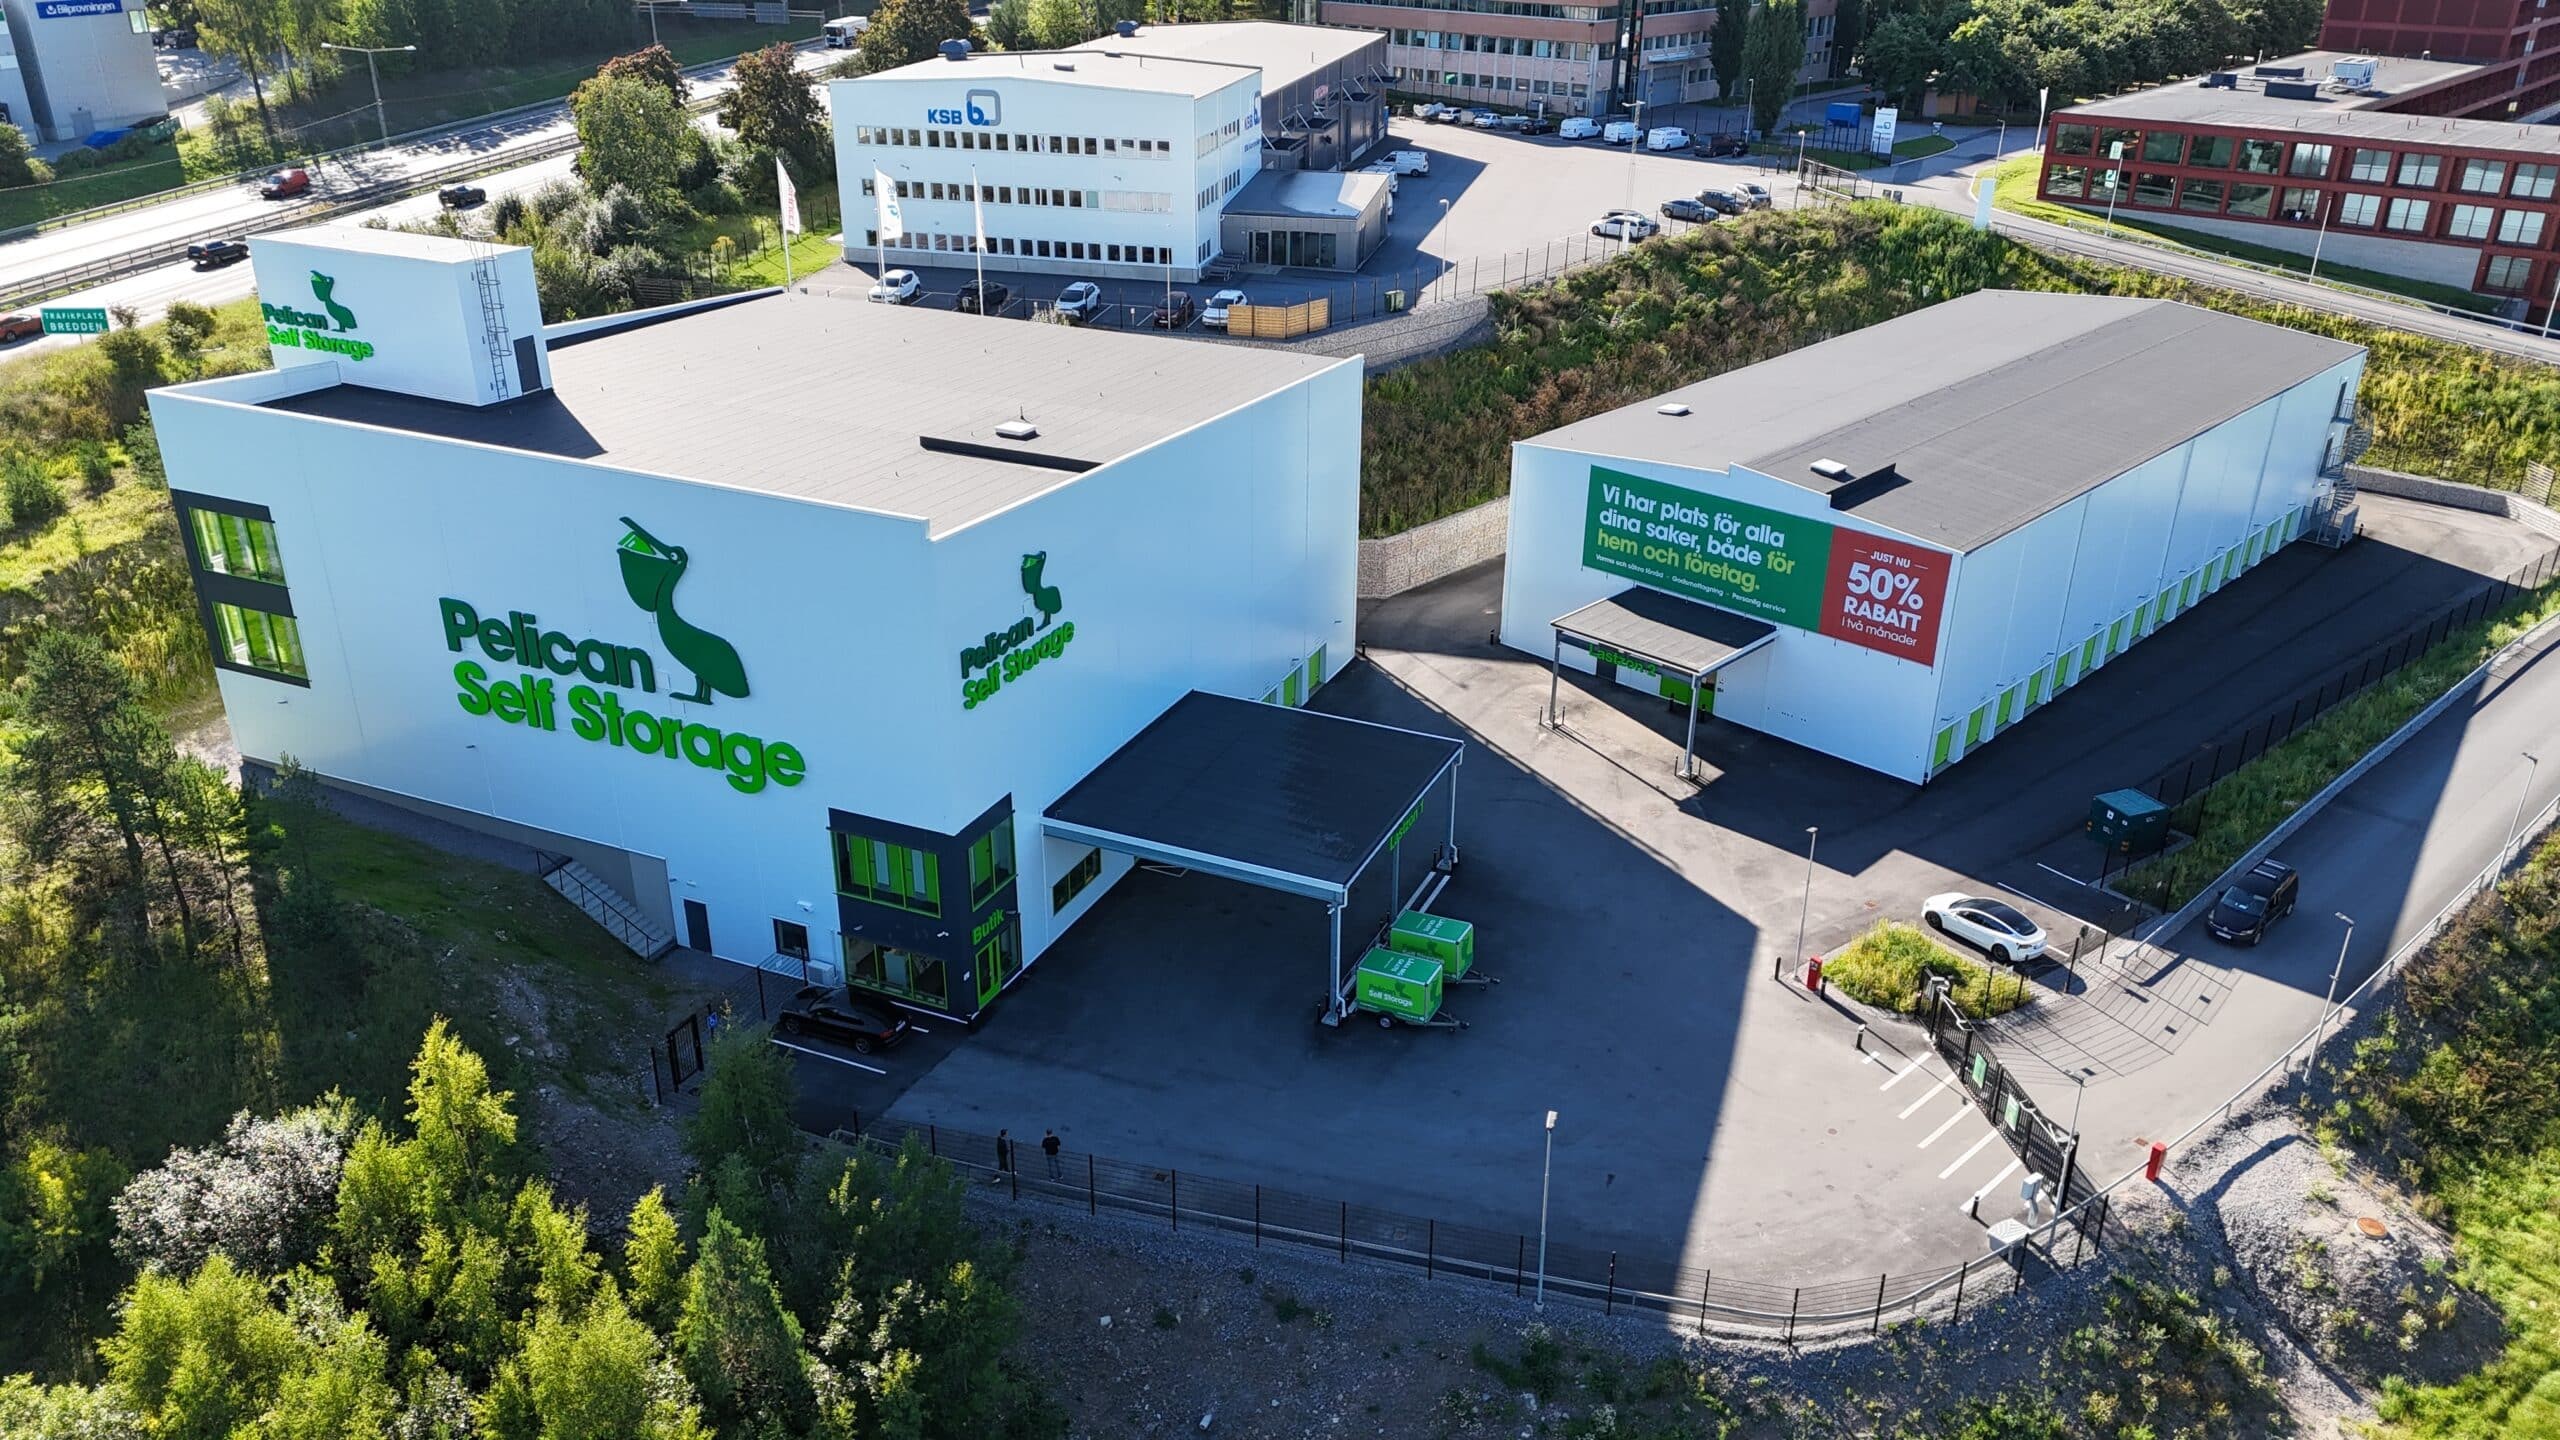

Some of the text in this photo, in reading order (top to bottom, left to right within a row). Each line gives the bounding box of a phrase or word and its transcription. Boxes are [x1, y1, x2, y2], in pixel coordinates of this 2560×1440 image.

[57, 2, 115, 16] Bilprovningen
[928, 108, 963, 125] KSB
[44, 312, 104, 320] TRAFIKPLATS
[50, 322, 103, 332] BREDDEN
[261, 302, 328, 330] Pelican
[267, 325, 374, 361] Self Storage
[1603, 483, 1785, 548] Vi har plats för alla
[1599, 509, 1797, 575] dina saker, både för
[1870, 551, 1911, 568] JUST NU
[1598, 528, 1760, 593] hem och företag.
[1732, 592, 1761, 608] Personlig
[1762, 602, 1786, 614] service
[1847, 562, 1924, 610] 50%
[1843, 595, 1921, 632] RABATT
[439, 596, 657, 693] Pelican
[960, 616, 1034, 679] Pelican
[1846, 617, 1863, 631] två
[1866, 625, 1917, 647] månader
[962, 621, 1075, 709] Self Storage
[1589, 642, 1657, 677] Lastzon 2
[453, 660, 806, 794] Self Storage
[972, 908, 1004, 946] Butik
[1368, 989, 1383, 1000] Self
[1383, 993, 1413, 1007] Storage
